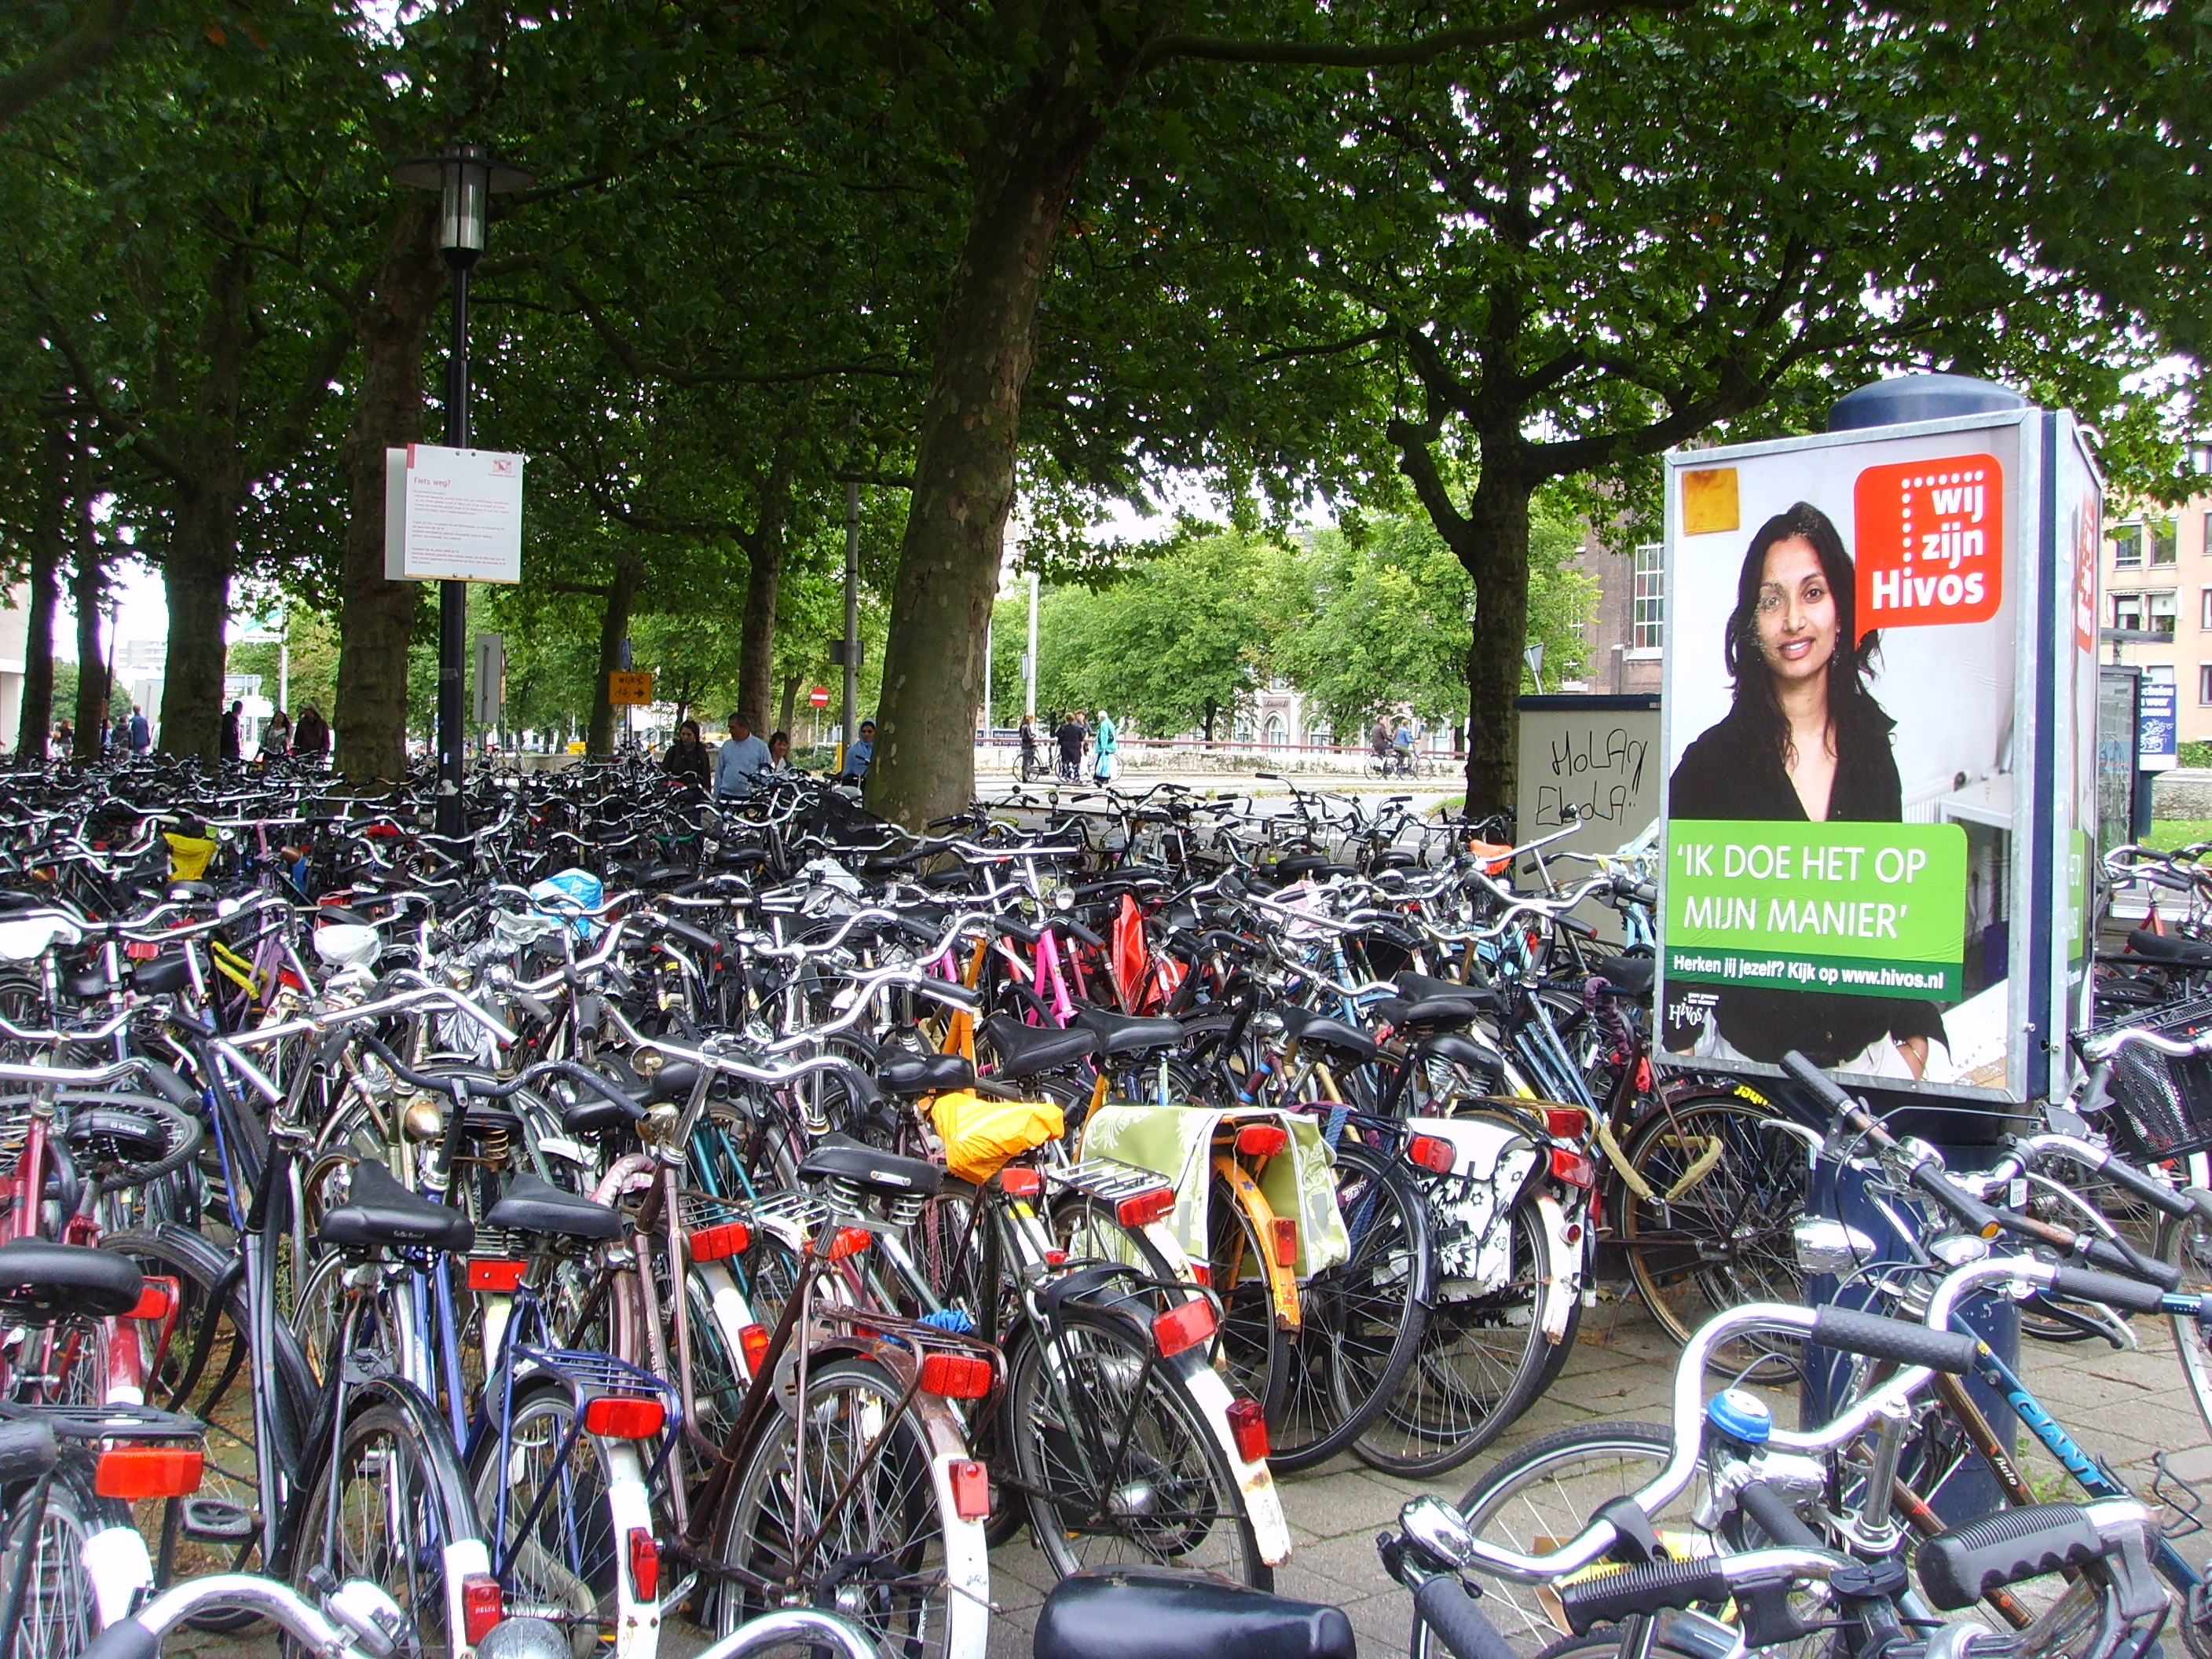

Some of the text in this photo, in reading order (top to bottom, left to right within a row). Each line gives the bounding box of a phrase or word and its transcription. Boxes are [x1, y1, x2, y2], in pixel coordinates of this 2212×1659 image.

[413, 476, 452, 488] Fiets weg?
[1931, 471, 1984, 524] wij
[1921, 522, 1984, 569] zijn
[1872, 566, 1984, 610] Hivos
[1676, 843, 1926, 884] 'IK DOE HET OP
[1683, 895, 1908, 939] MIJN MANIER'
[1673, 954, 1944, 989] Herken jij jezelf? Kijk op www.hivos.nl
[1668, 997, 1703, 1030] Hivos
[2007, 1390, 2117, 1492] GIANT
[475, 1605, 496, 1614] DELTA
